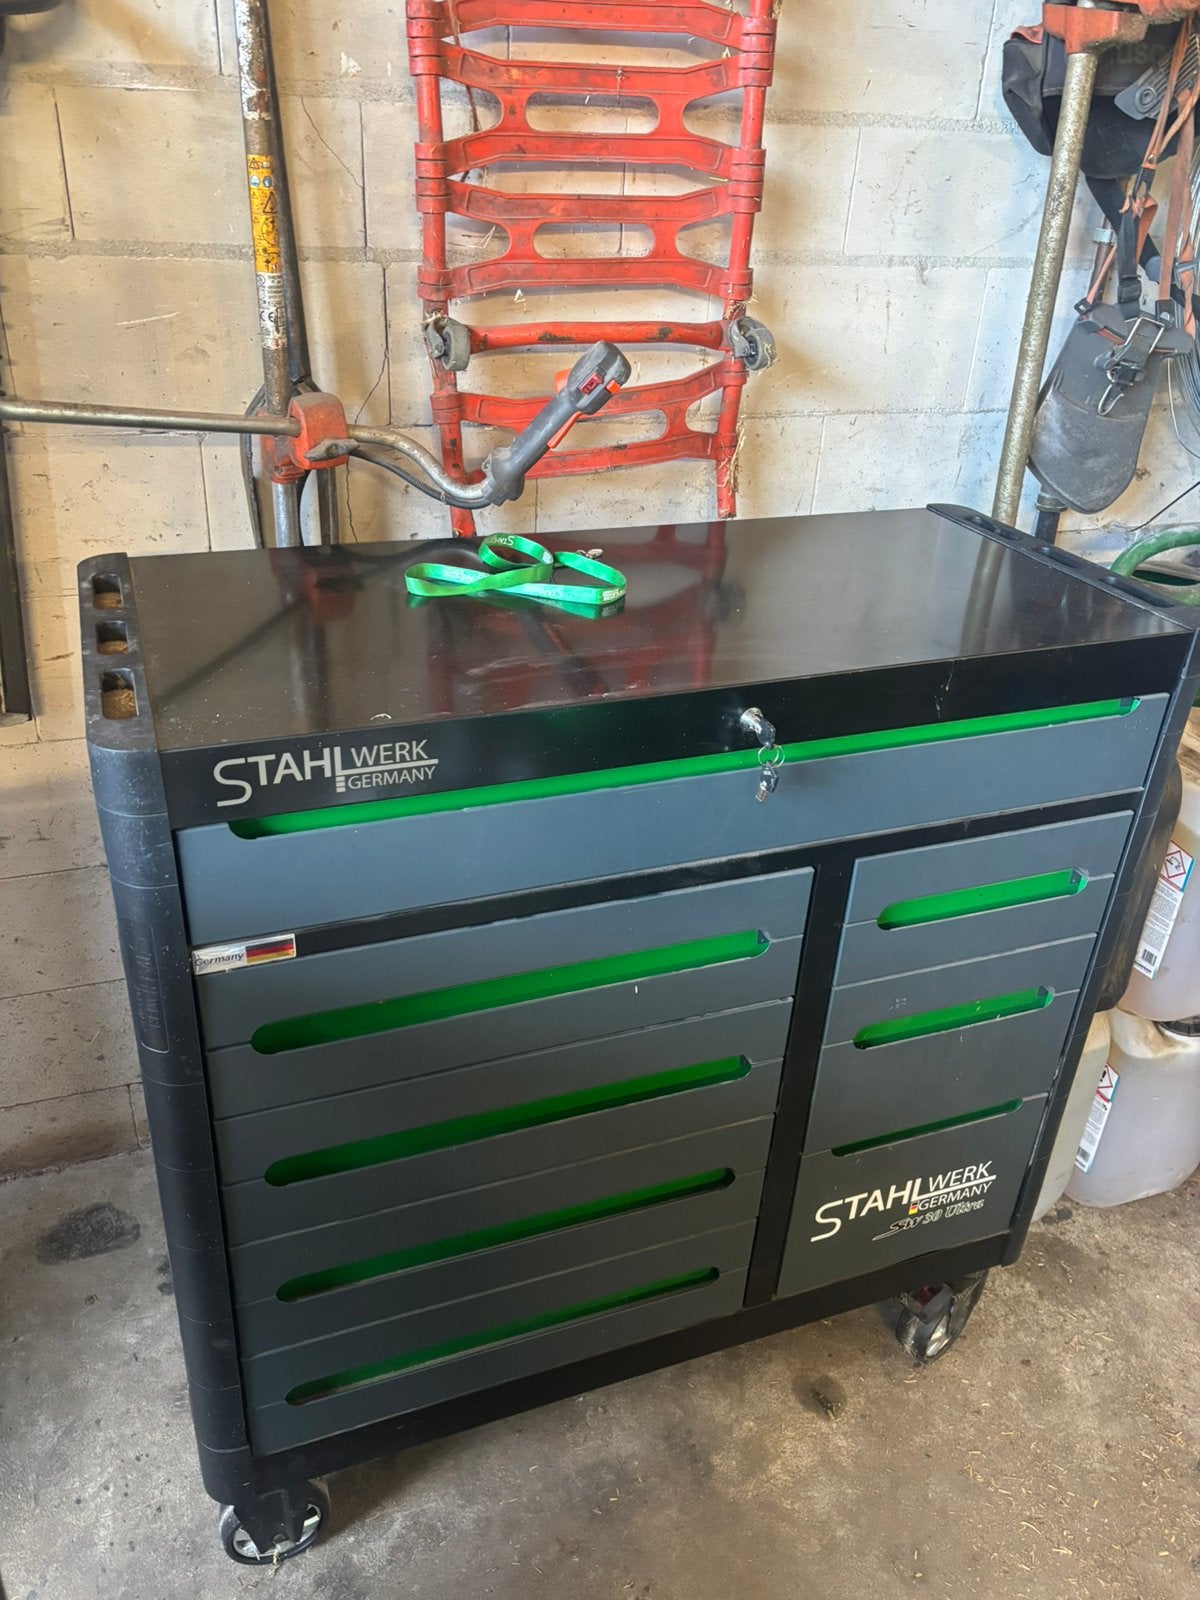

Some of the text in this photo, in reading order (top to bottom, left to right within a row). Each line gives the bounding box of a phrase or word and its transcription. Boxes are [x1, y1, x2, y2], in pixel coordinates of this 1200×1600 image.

[348, 765, 436, 790] GERMANY
[194, 951, 245, 967] Germany
[918, 1181, 992, 1211] GERMANY
[944, 1198, 985, 1219] Ultra
